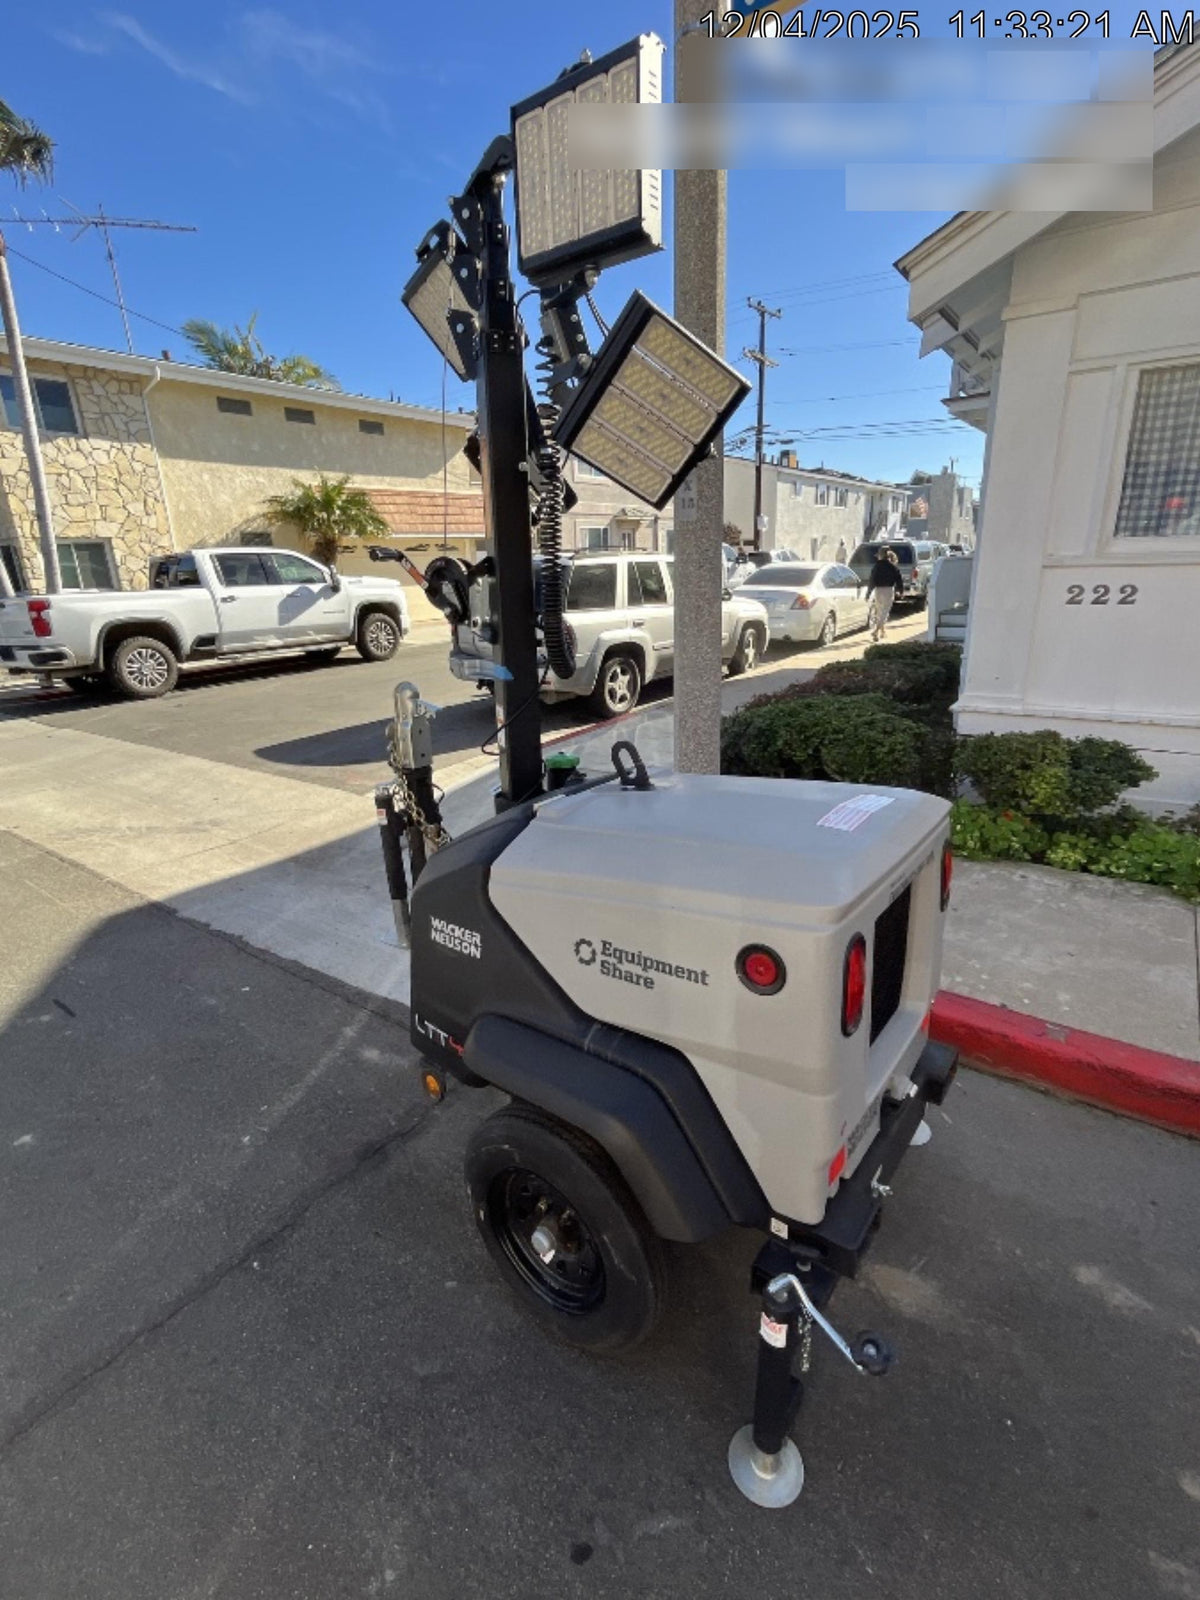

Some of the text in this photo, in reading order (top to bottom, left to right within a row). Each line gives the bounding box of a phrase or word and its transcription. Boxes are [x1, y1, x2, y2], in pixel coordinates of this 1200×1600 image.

[1065, 584, 1139, 605] 222
[430, 915, 482, 946] WACKER
[431, 927, 481, 959] NEUSON
[600, 939, 710, 986] Equipment
[600, 959, 655, 989] Share
